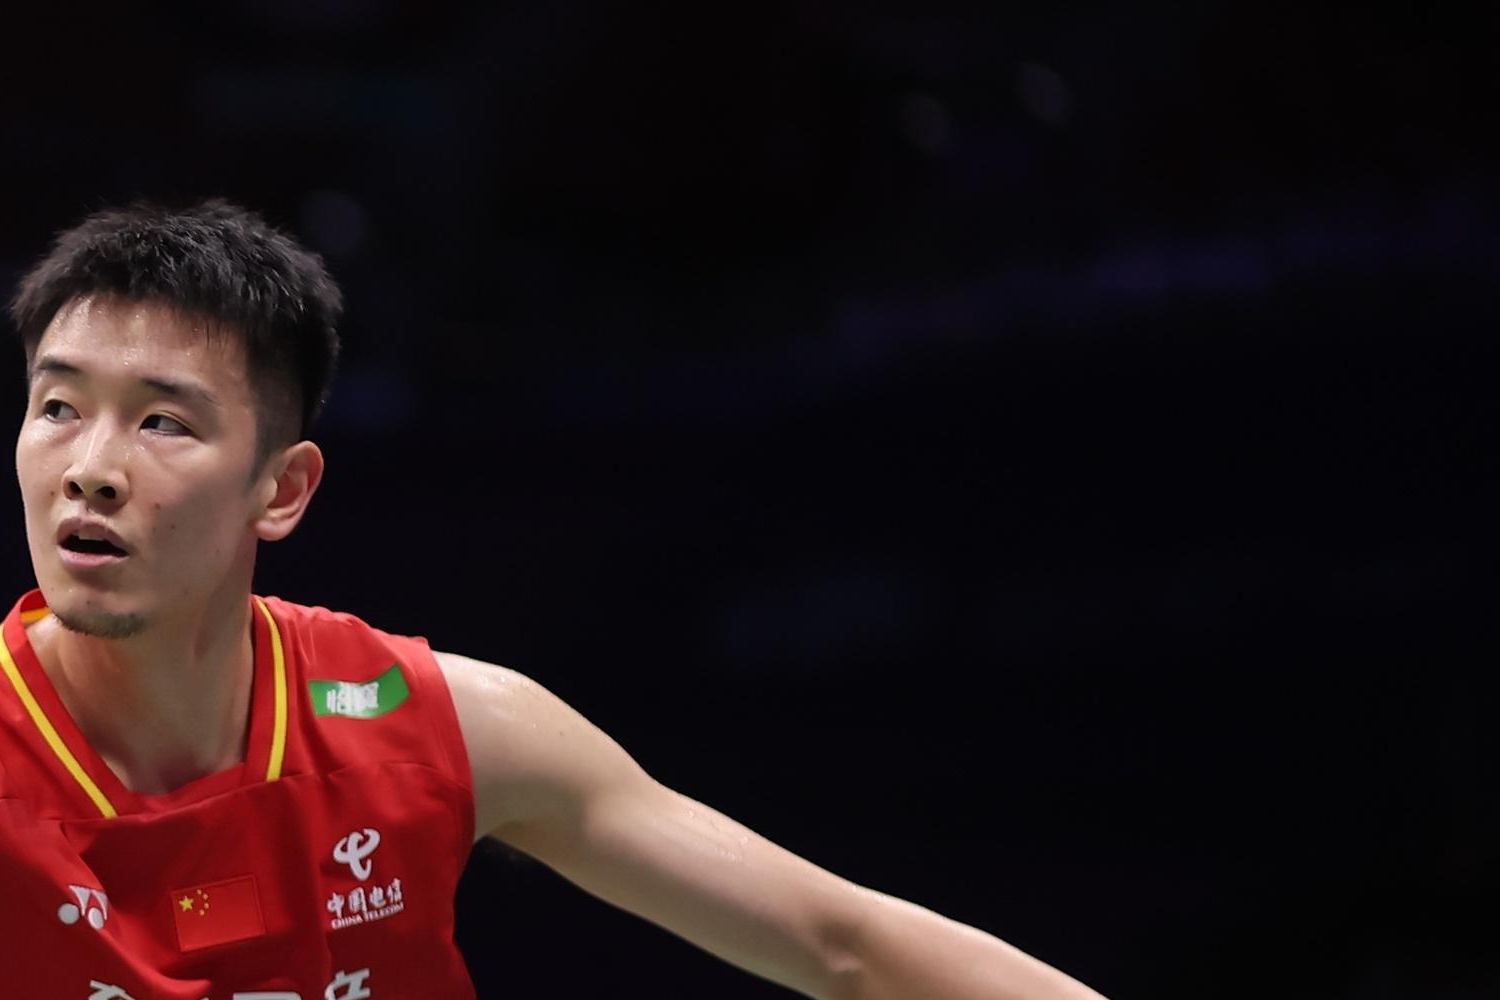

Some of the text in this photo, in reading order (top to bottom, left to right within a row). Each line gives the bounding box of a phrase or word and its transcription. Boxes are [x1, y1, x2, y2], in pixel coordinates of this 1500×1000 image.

[327, 877, 402, 919] 中国电信
[331, 914, 363, 930] CHINA
